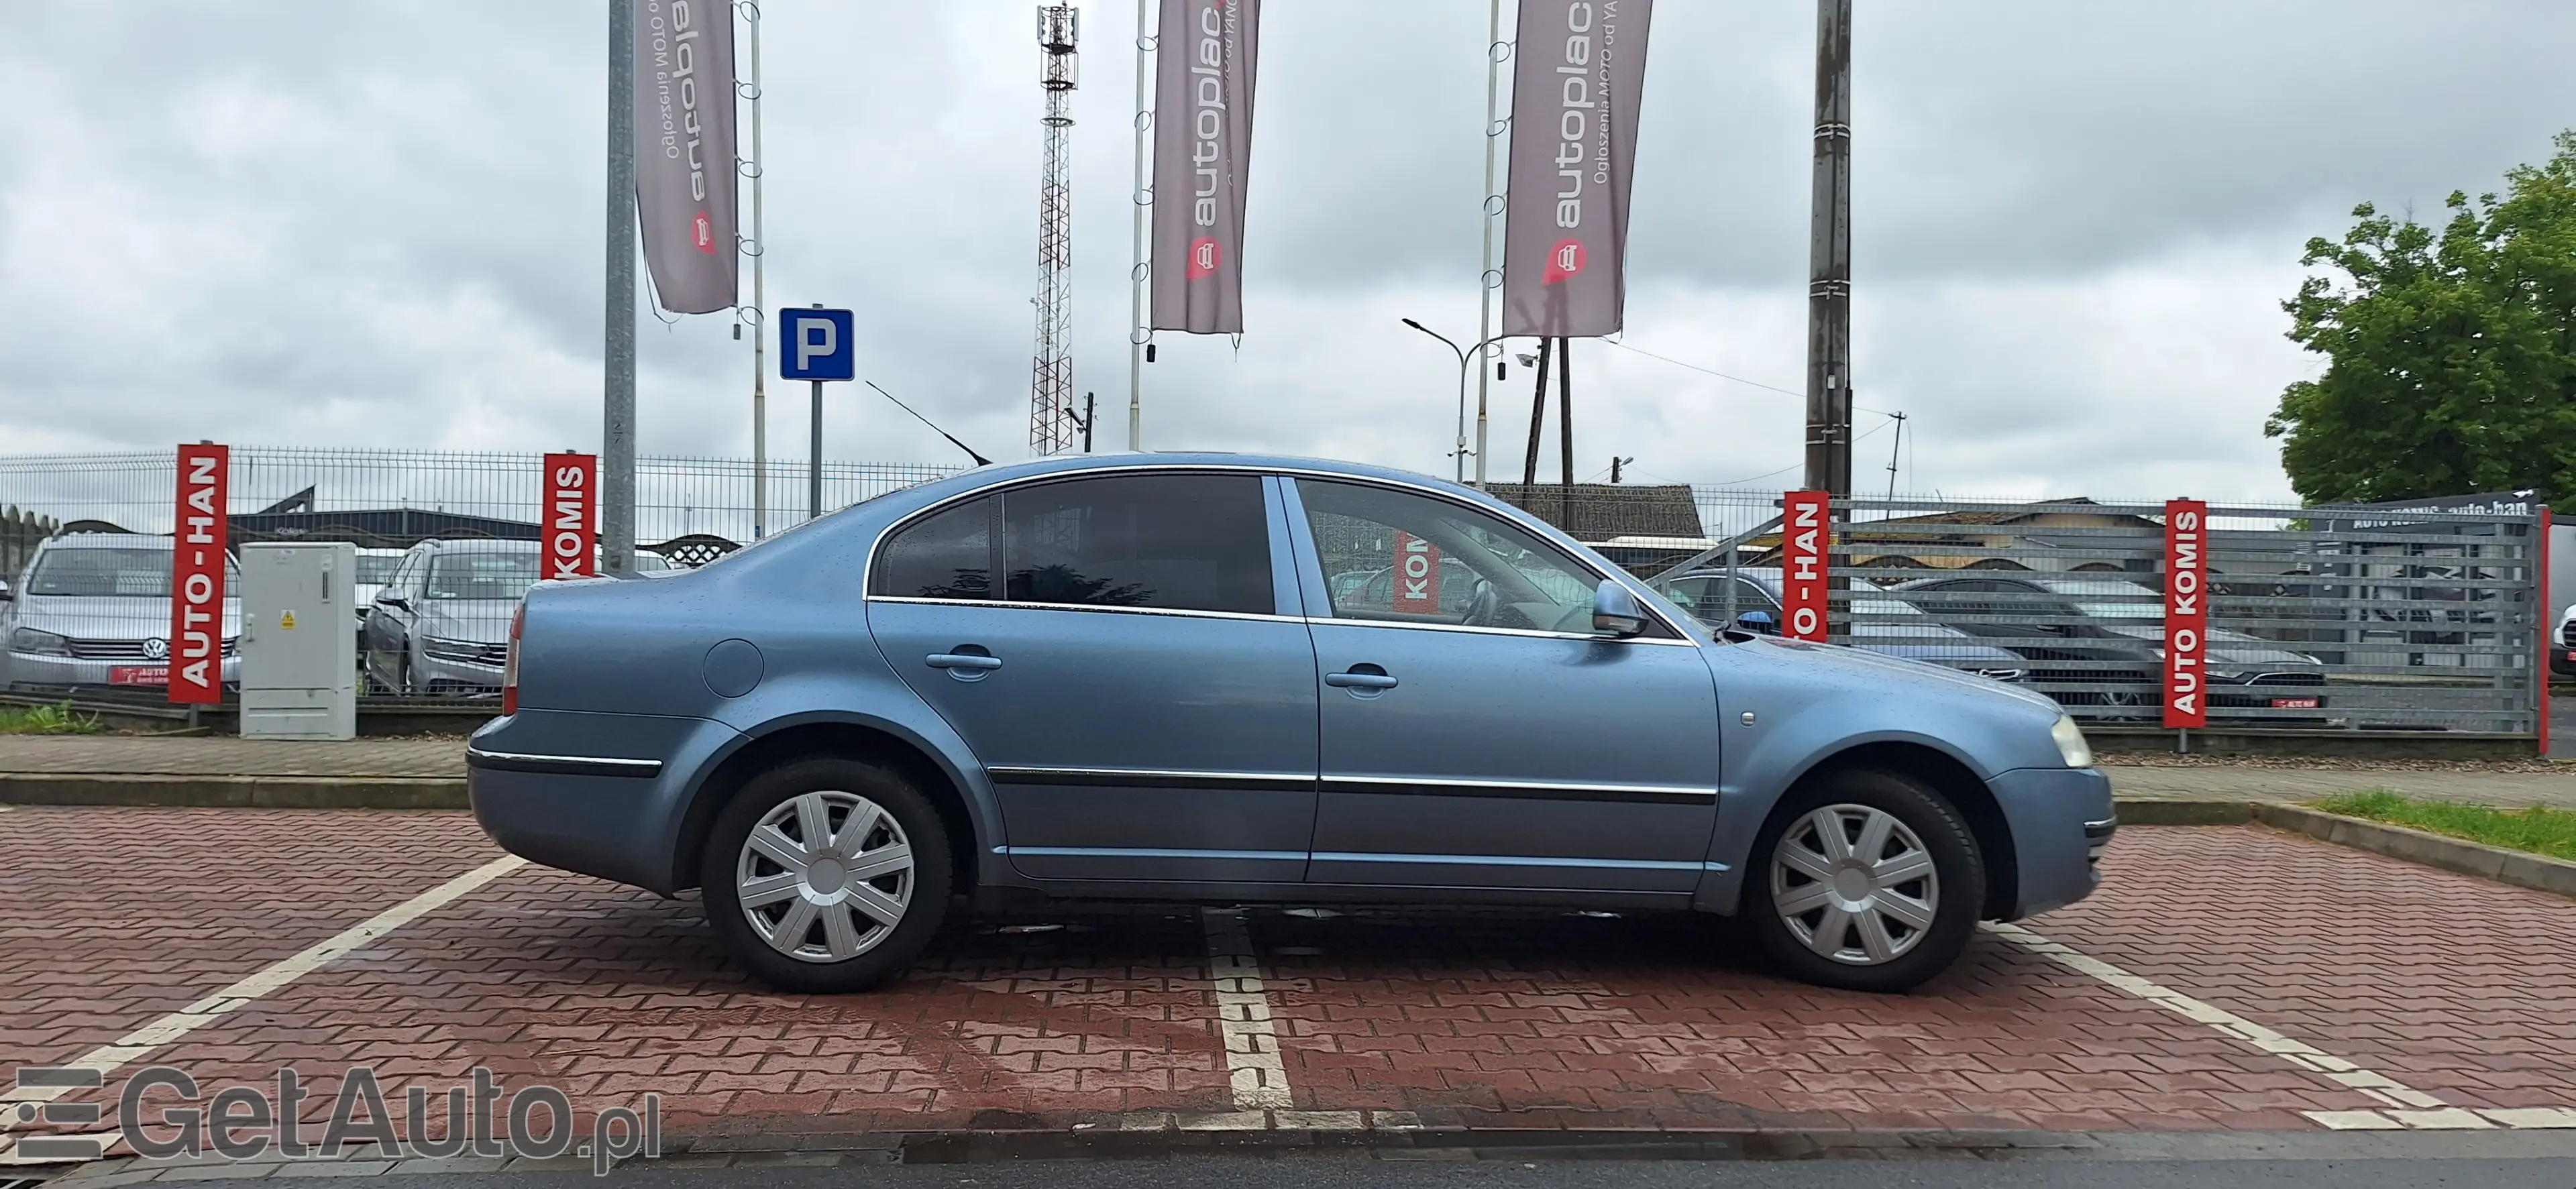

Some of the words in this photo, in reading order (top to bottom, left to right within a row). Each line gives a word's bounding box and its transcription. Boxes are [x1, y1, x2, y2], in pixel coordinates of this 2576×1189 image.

[1599, 48, 1611, 97] MOTO
[1602, 23, 1615, 45] od
[1191, 7, 1226, 227] autoplac
[1554, 2, 1595, 228] autoplac
[1594, 101, 1610, 184] Ogłoszenia
[796, 318, 837, 370] P
[554, 466, 584, 579] KOMIS
[2175, 511, 2198, 614] KOMIS
[2174, 628, 2198, 715] AUTO
